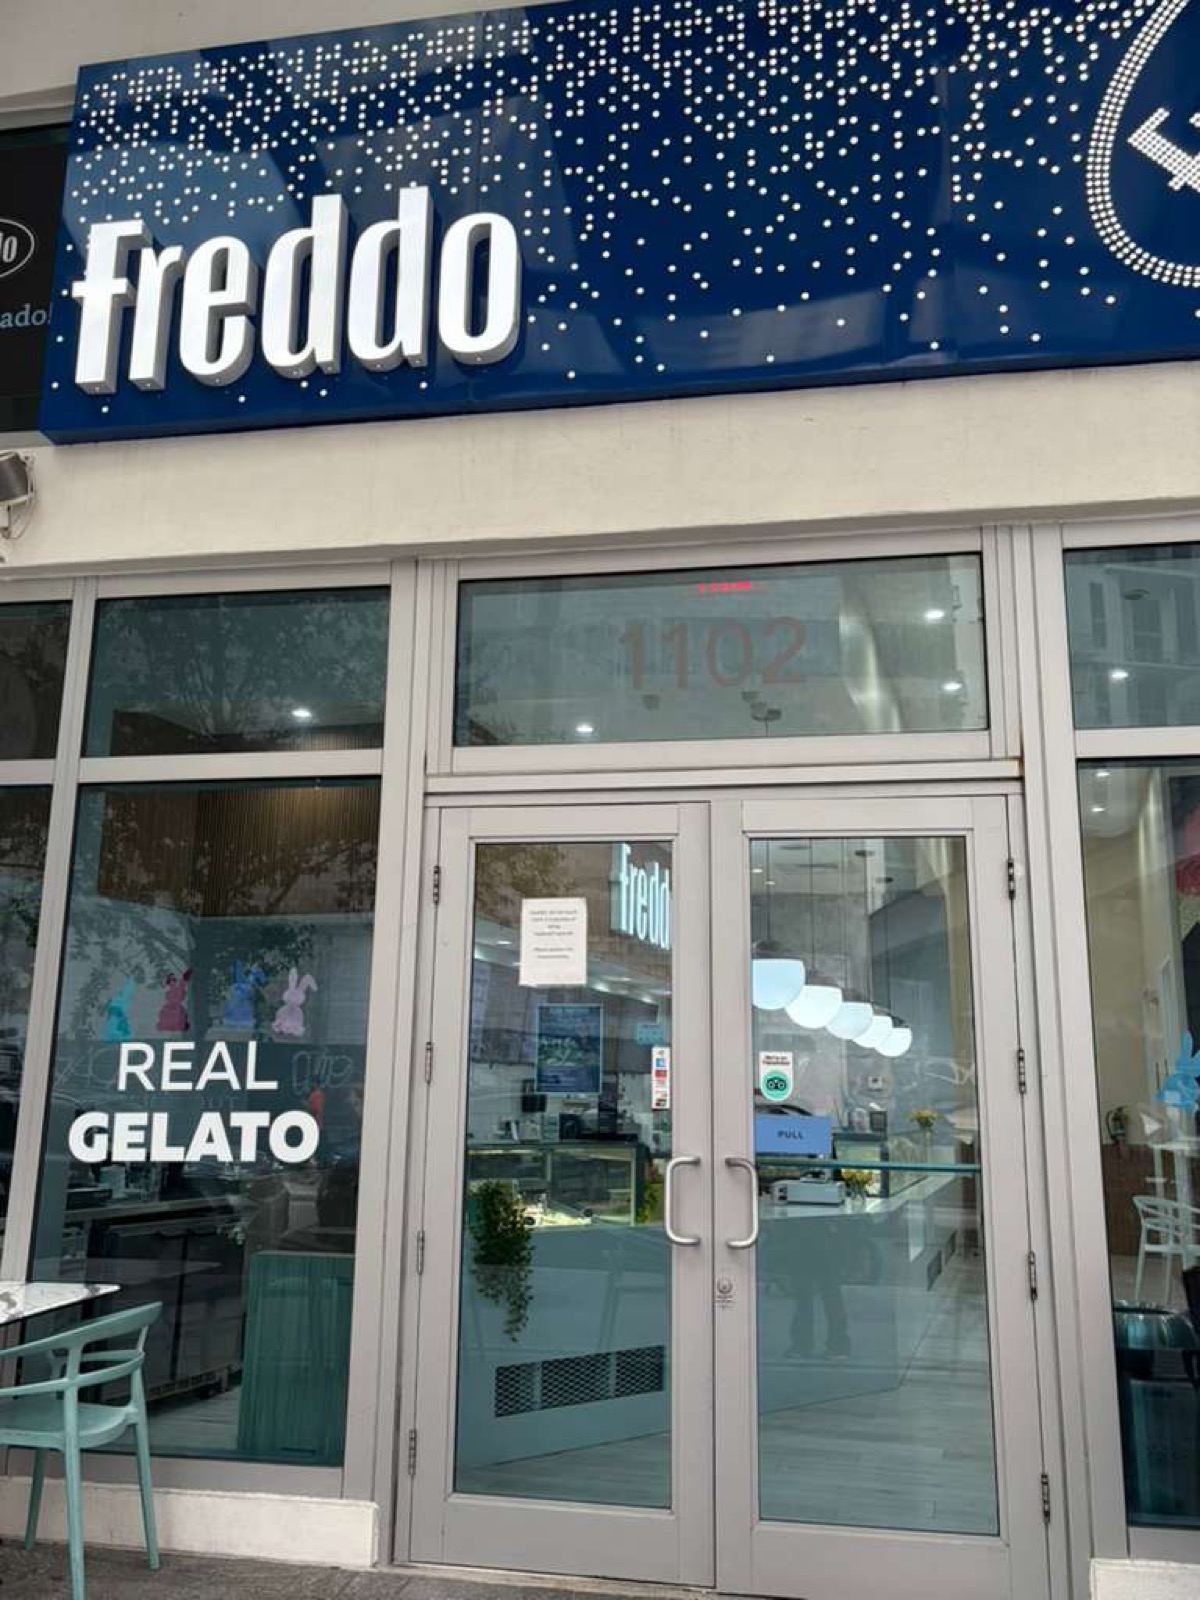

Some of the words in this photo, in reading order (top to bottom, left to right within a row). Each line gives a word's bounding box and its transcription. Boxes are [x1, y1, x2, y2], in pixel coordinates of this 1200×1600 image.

[72, 186, 520, 392] freddo
[618, 617, 806, 689] 1102
[117, 1041, 279, 1091] REAL
[68, 1111, 320, 1163] GELATO
[777, 1129, 803, 1140] PULL
